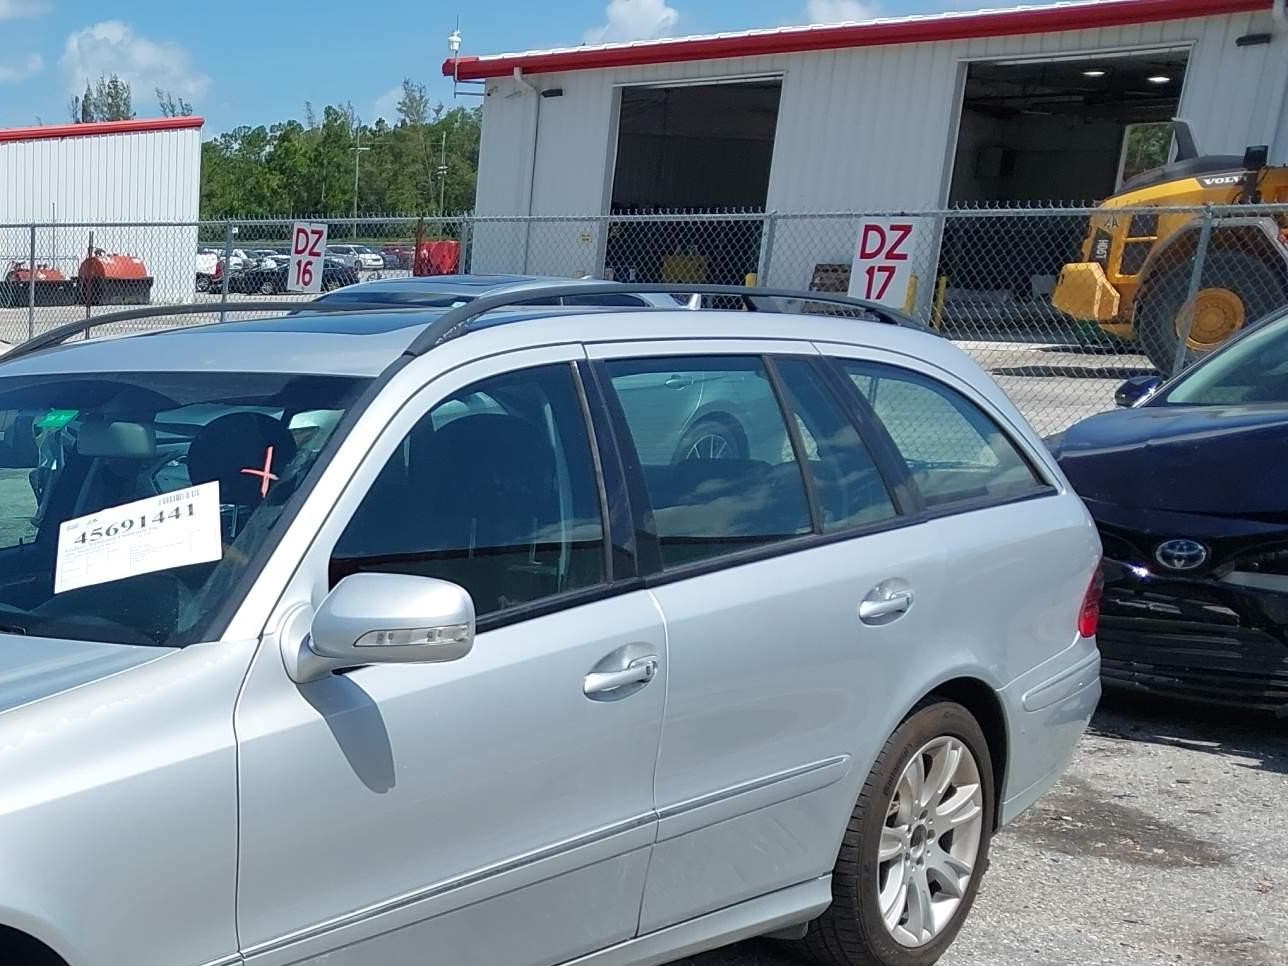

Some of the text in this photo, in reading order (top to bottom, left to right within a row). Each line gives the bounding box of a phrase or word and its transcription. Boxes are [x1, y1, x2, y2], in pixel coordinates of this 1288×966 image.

[1204, 175, 1247, 185] VOLV
[295, 227, 324, 257] DZ
[860, 224, 913, 260] DZ
[295, 260, 313, 287] 16
[865, 266, 896, 299] 17
[73, 503, 197, 544] 45691441
